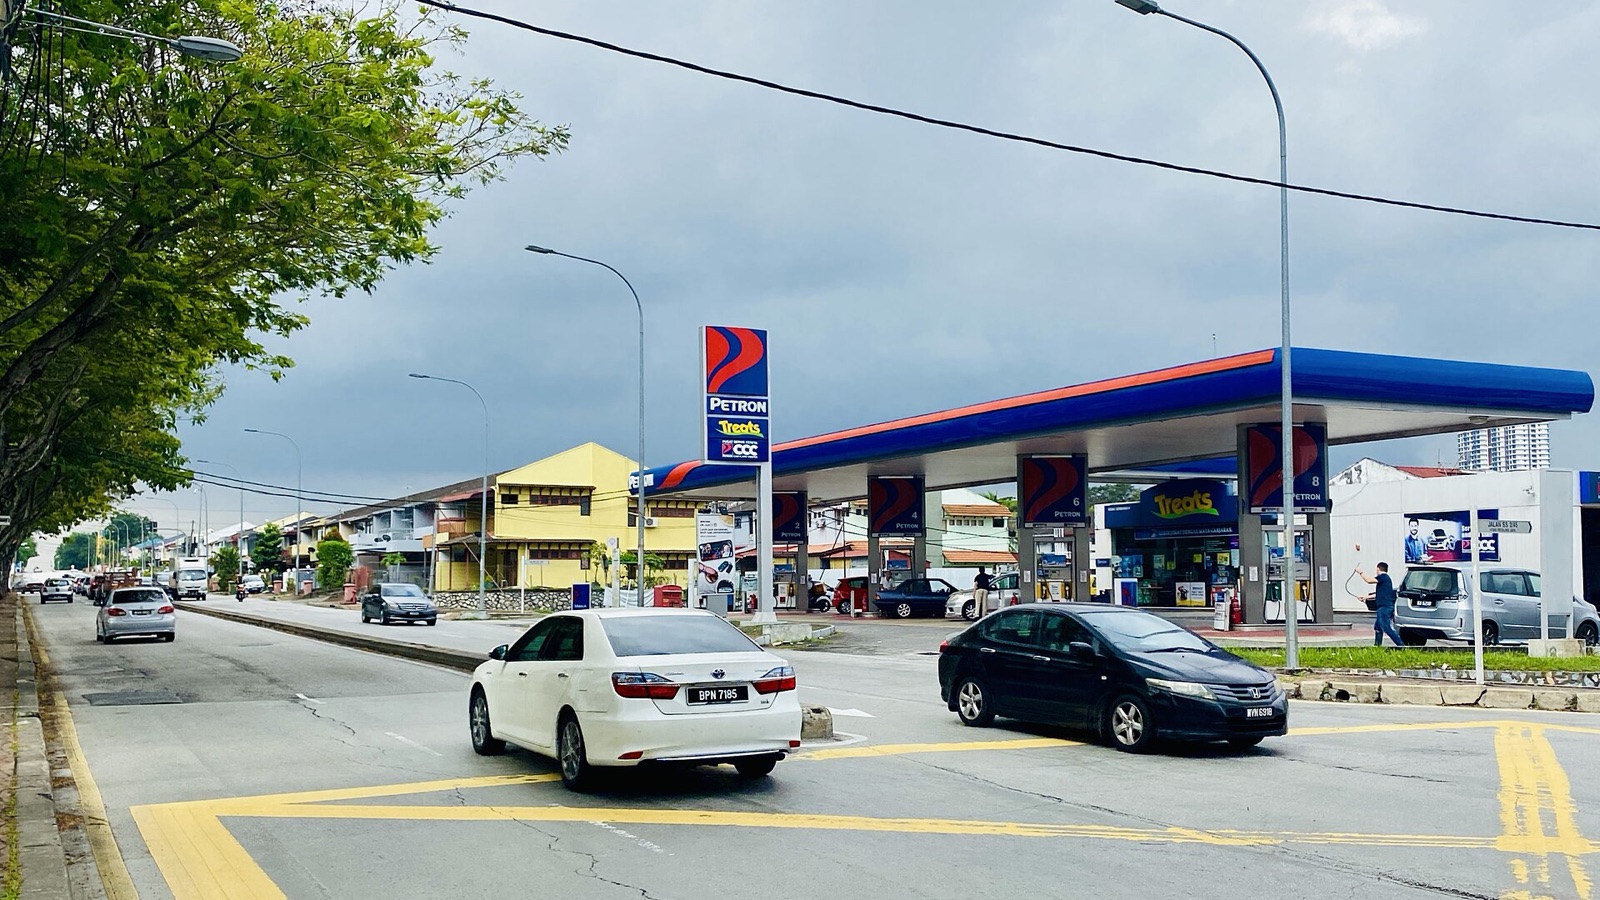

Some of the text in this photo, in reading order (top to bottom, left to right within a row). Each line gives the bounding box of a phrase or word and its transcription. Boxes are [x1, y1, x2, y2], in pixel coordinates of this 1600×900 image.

[710, 397, 767, 413] PETRON
[718, 420, 761, 434] Treats
[732, 443, 758, 456] CCC
[1312, 476, 1320, 487] 8
[1073, 497, 1080, 506] 6
[1154, 489, 1213, 516] Treats
[911, 511, 918, 519] 4
[1054, 510, 1081, 518] PETRON
[698, 688, 738, 701] BPN 7185
